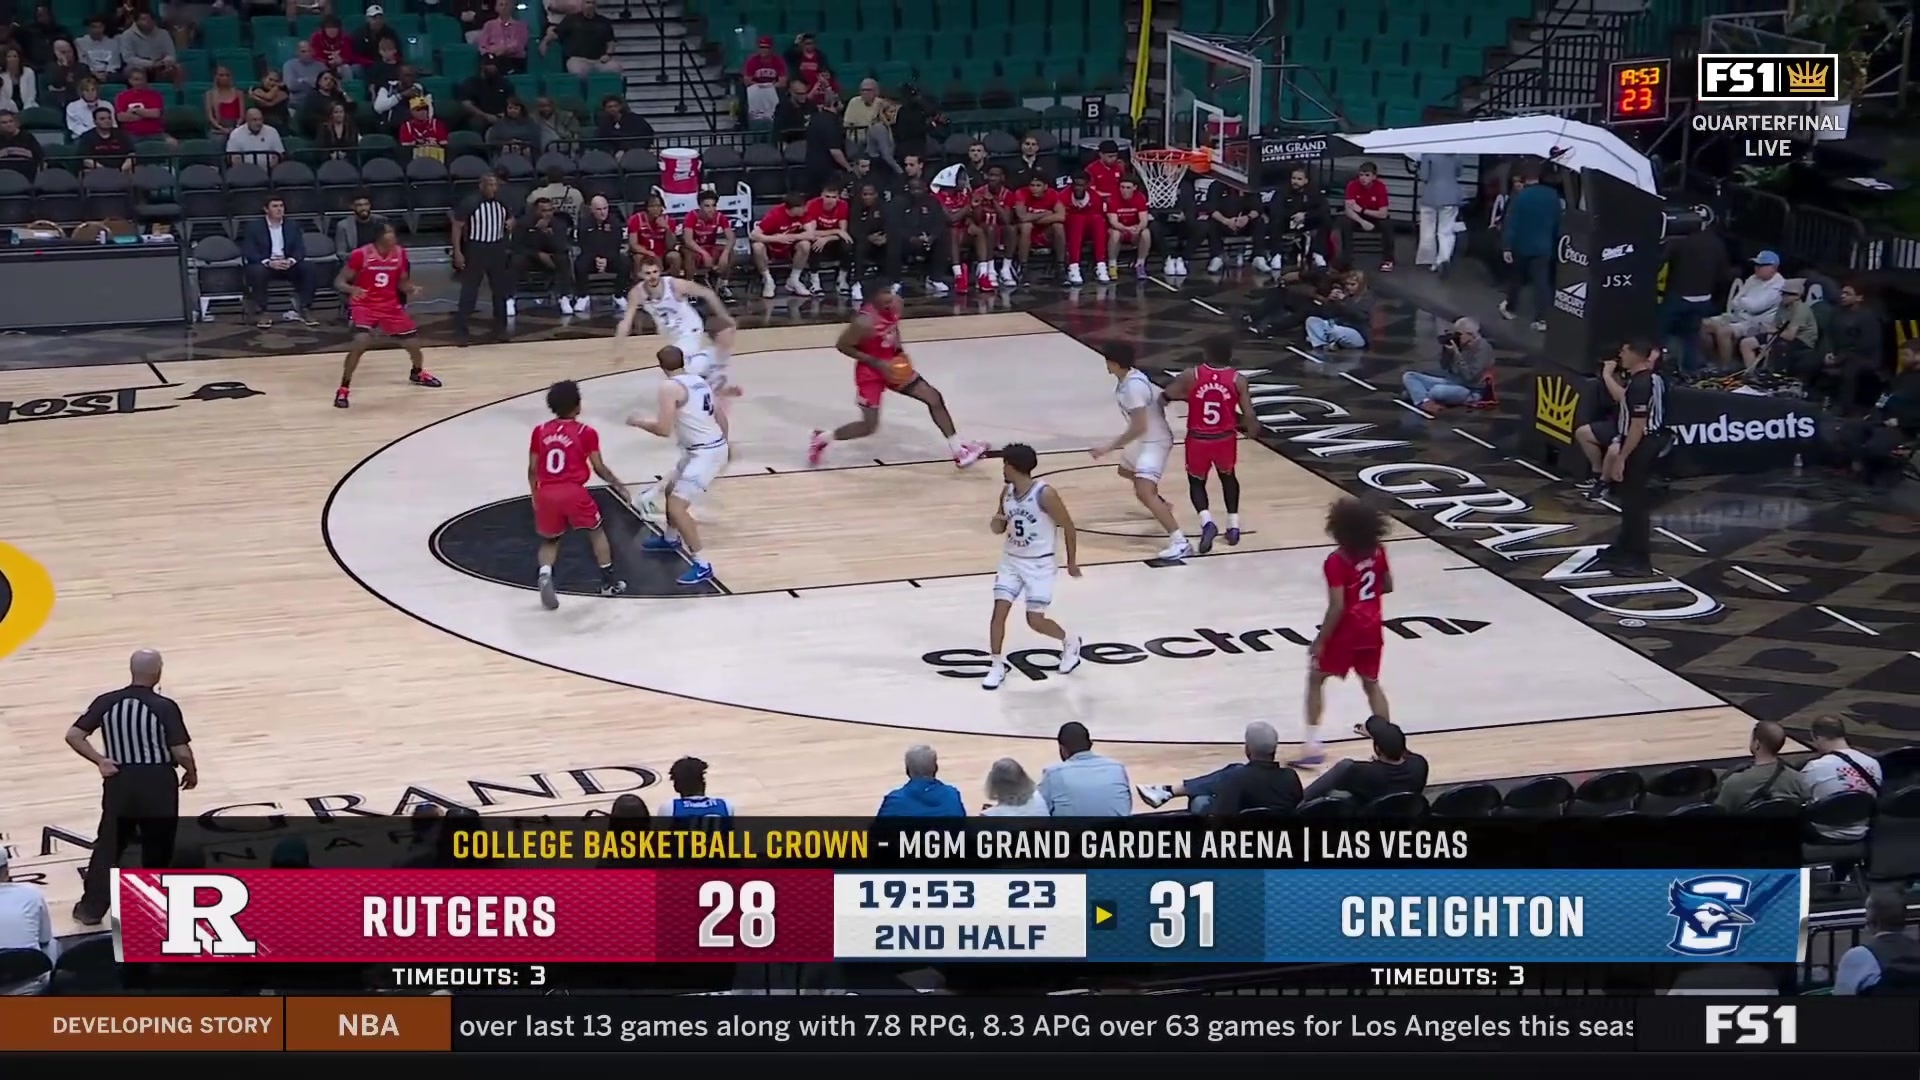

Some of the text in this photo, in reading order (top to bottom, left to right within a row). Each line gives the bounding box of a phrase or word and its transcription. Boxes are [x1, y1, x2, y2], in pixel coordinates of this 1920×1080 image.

[1087, 103, 1100, 118] B
[1622, 88, 1652, 111] 23
[1286, 140, 1327, 152] GRAND
[1558, 234, 1589, 267] Circa
[373, 271, 390, 288] 9
[1602, 274, 1633, 288] JSX
[1202, 400, 1222, 426] 5
[545, 447, 567, 475] 0
[1013, 518, 1025, 538] 5
[1357, 462, 1725, 621] GRAND
[1358, 570, 1377, 602] 2
[198, 764, 662, 833] GRAND
